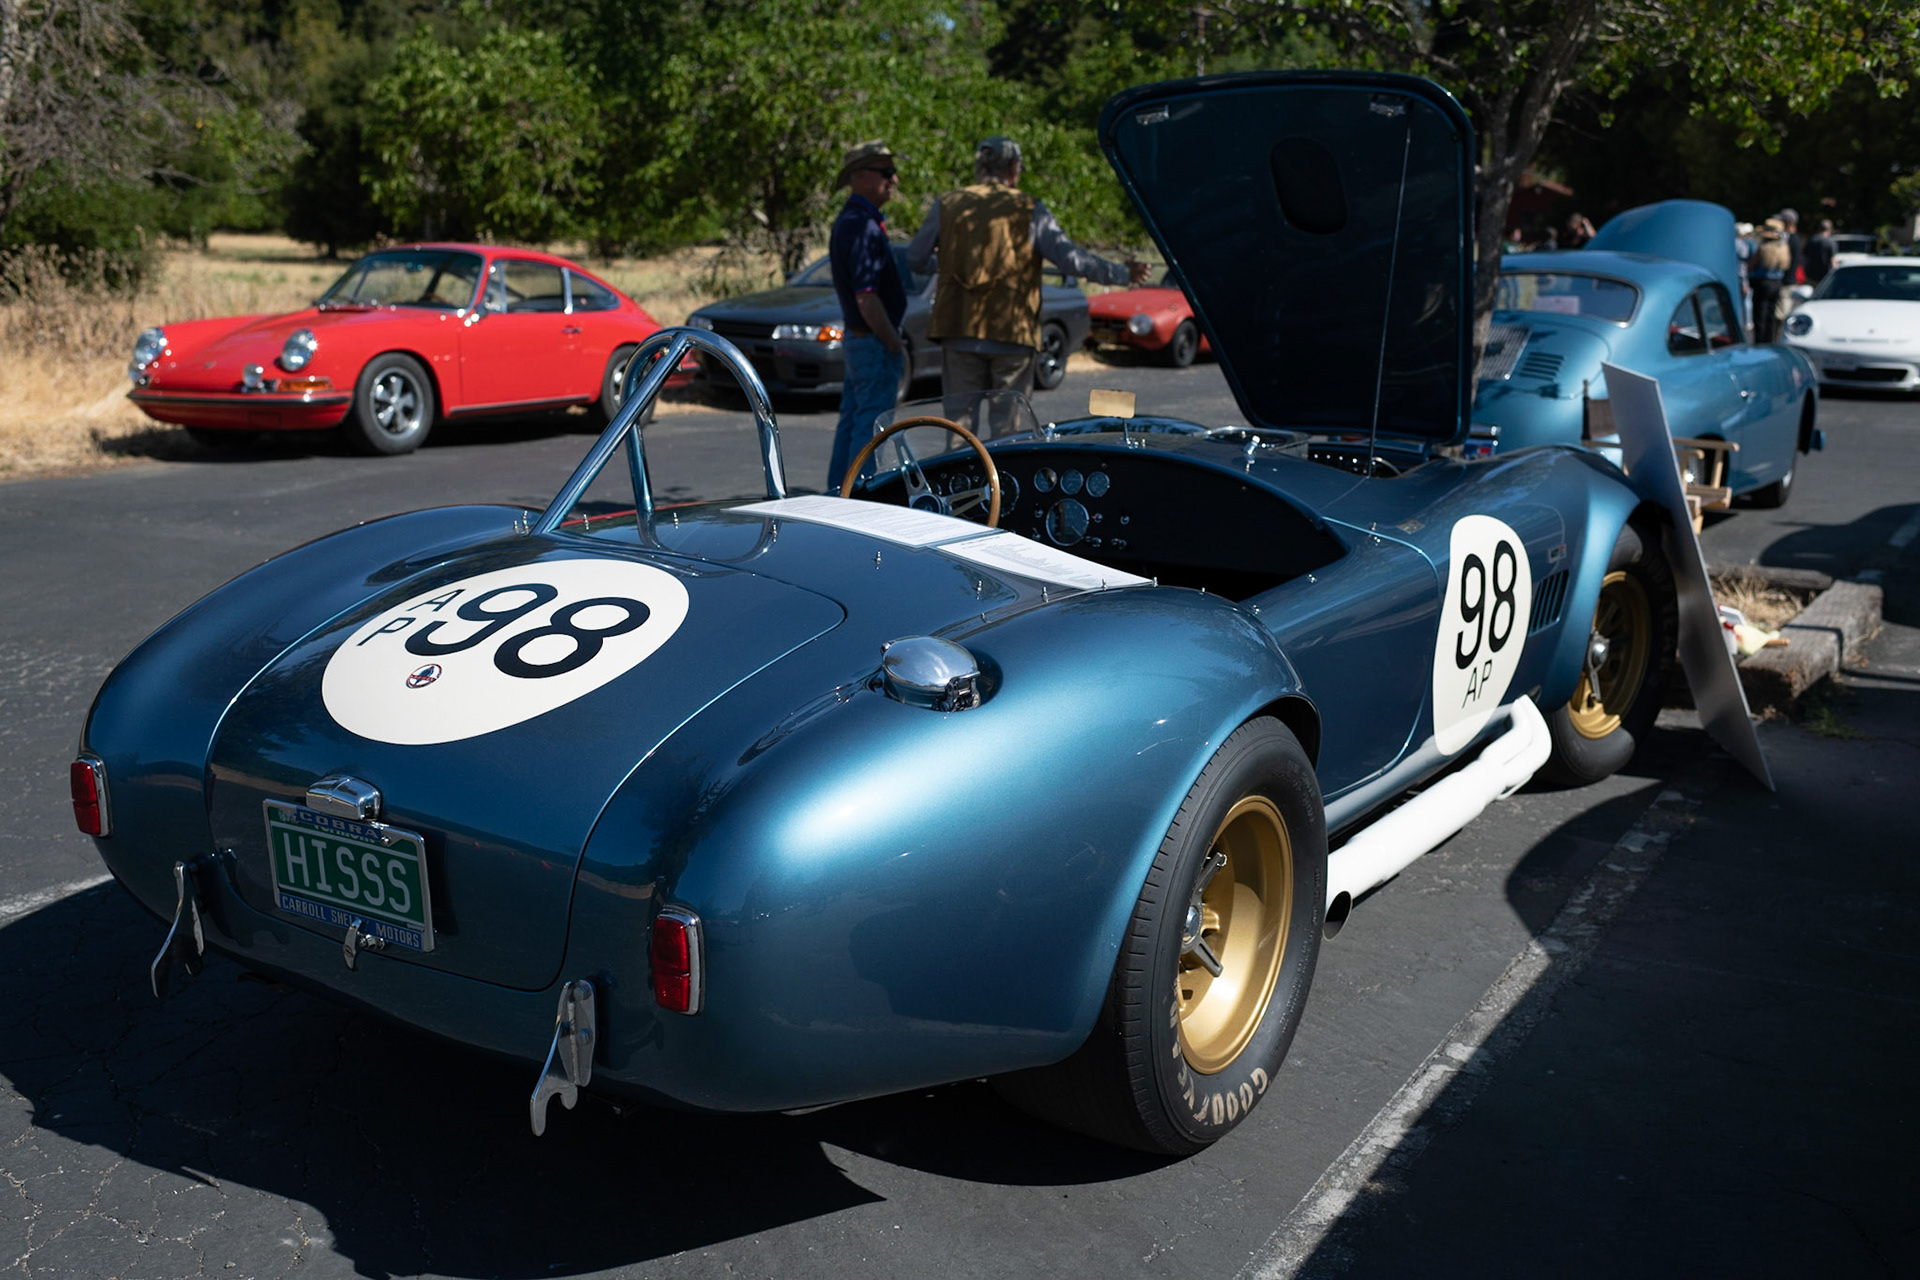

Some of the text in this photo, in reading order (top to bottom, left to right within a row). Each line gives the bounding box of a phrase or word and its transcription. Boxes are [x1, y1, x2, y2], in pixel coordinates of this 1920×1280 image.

[405, 583, 650, 678] 98
[1456, 540, 1517, 669] 98
[1462, 659, 1492, 708] AP
[300, 811, 379, 839] COBRA
[283, 832, 411, 913] HISSS
[282, 895, 326, 920] CARROLL
[376, 922, 419, 948] MOTORS
